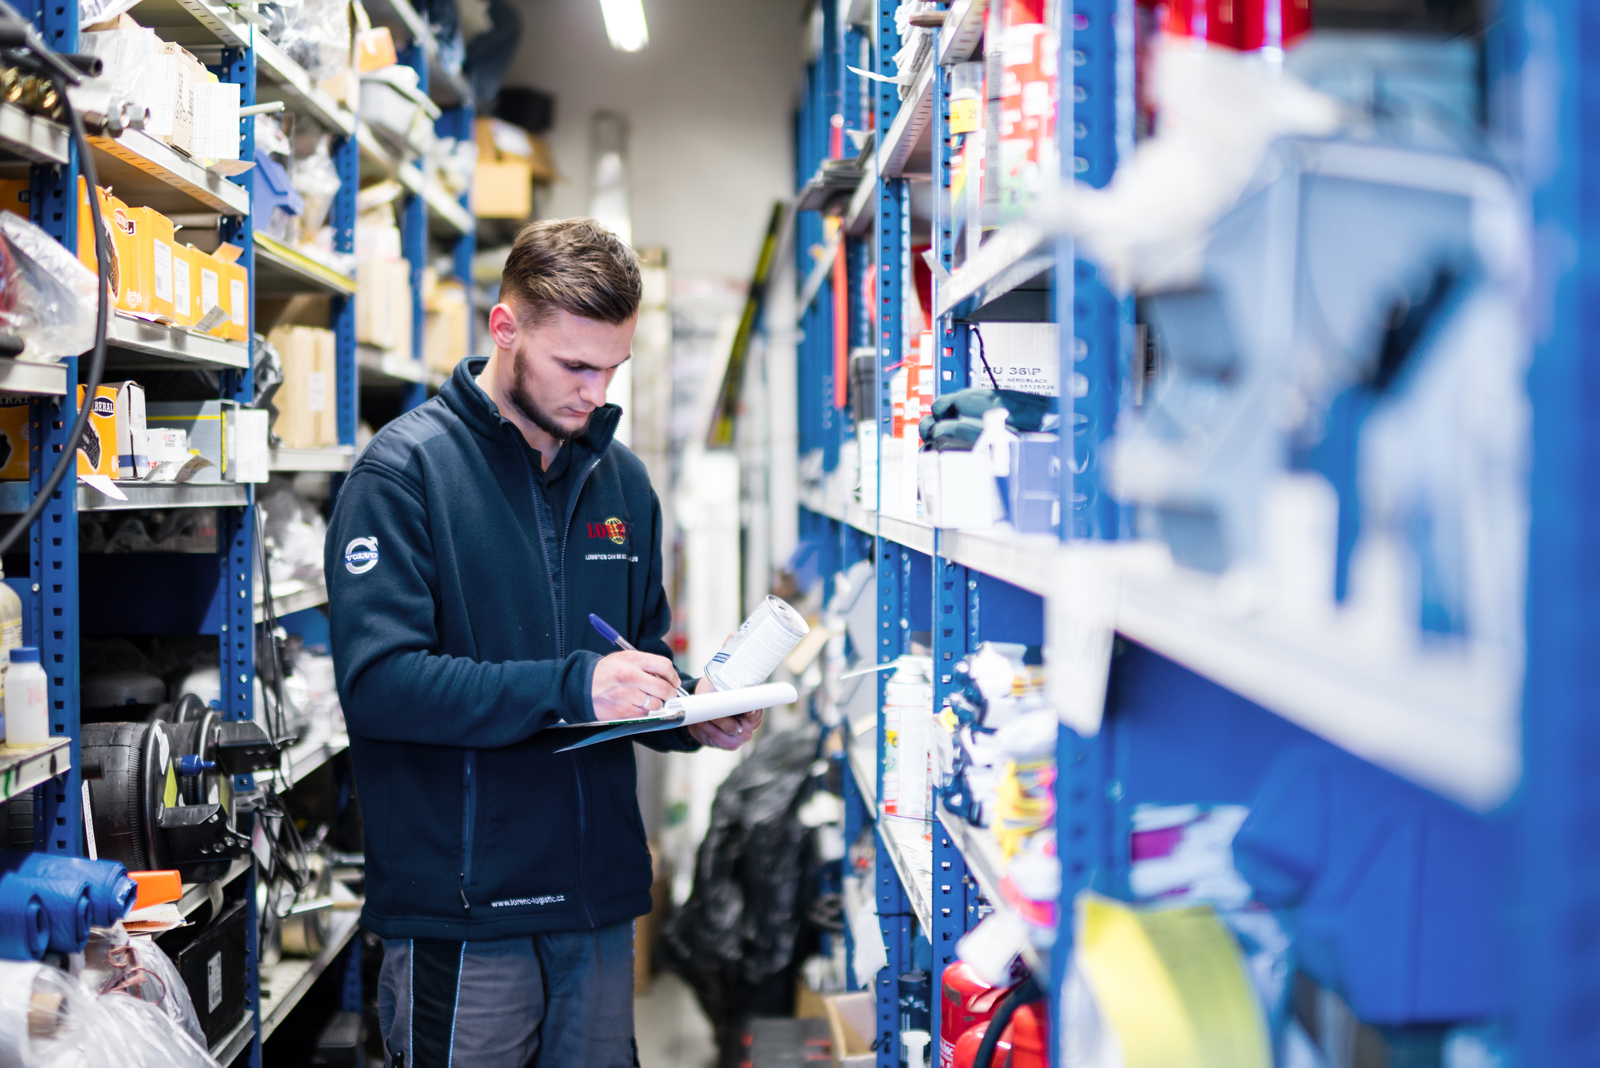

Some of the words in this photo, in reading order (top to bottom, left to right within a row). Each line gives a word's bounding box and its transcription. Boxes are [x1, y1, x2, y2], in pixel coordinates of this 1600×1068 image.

[94, 401, 114, 413] BERAL
[345, 552, 378, 562] VOLVO
[491, 895, 565, 907] www.lorenc-logistic.cz
